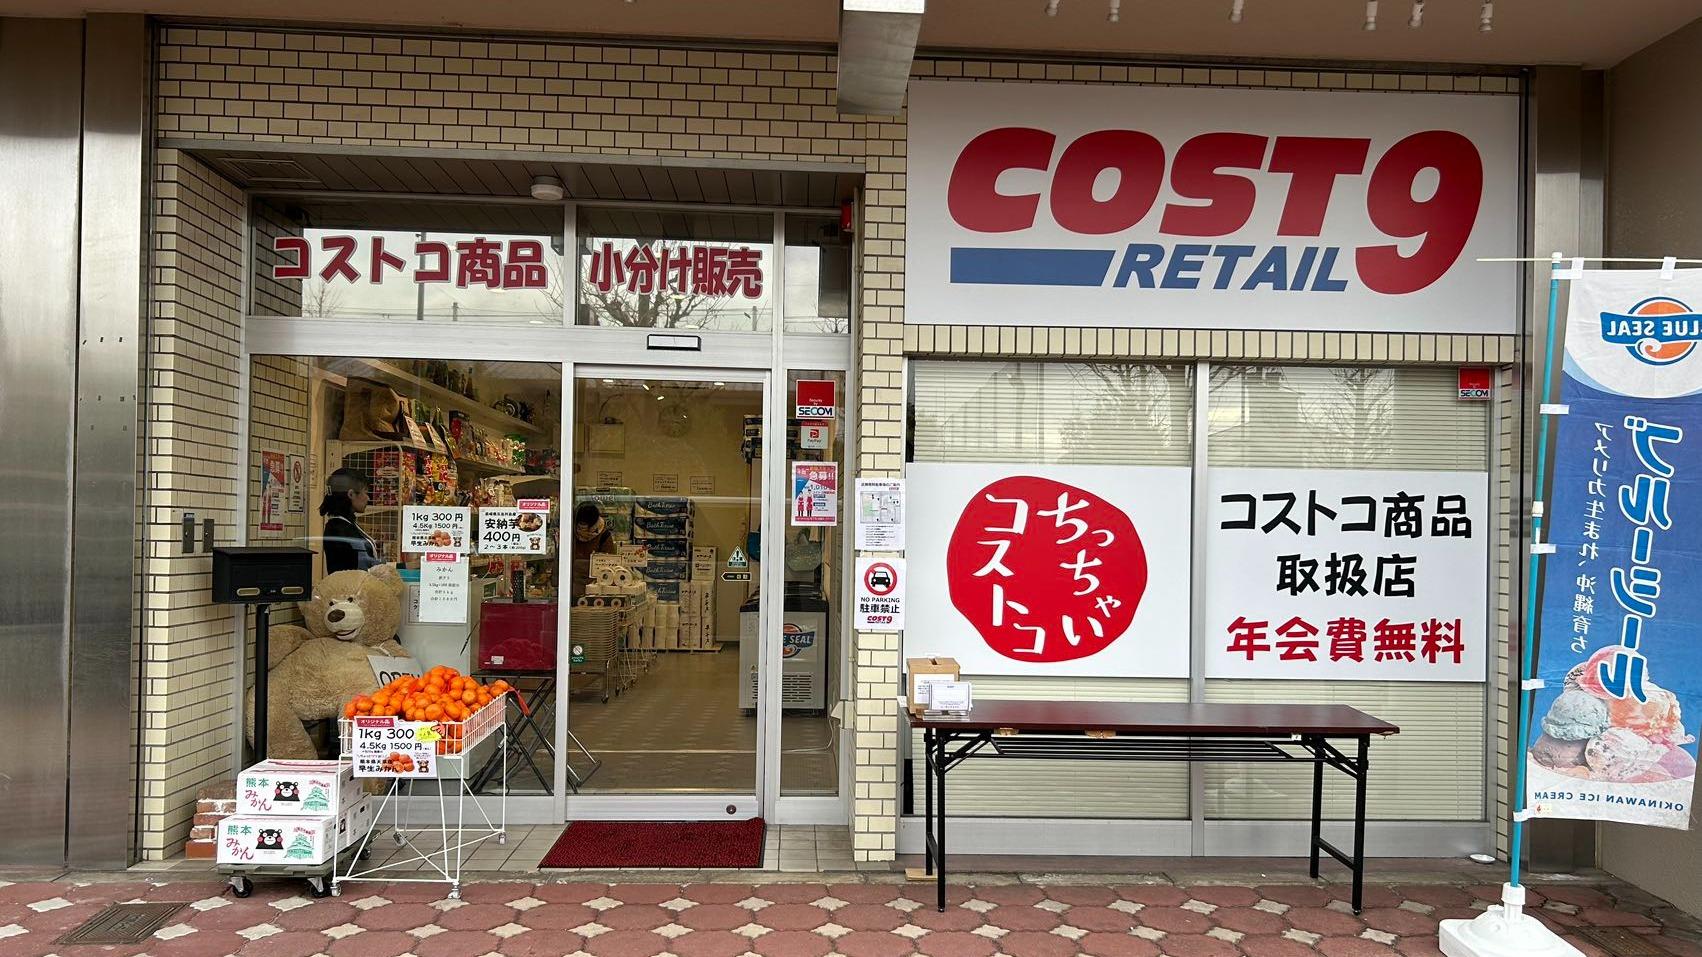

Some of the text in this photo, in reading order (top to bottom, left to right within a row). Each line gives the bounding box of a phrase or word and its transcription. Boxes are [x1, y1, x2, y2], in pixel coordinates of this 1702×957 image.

[946, 126, 1483, 295] COST9
[272, 235, 764, 299] コストコ商品 小分け販売
[1112, 244, 1349, 292] RETAIL
[1460, 389, 1488, 397] SECOM
[798, 407, 833, 416] SECOM
[432, 512, 452, 521] 300
[455, 513, 463, 522] 円
[1219, 490, 1474, 540] コストコ商品
[484, 518, 519, 529] 安納芋
[972, 492, 1046, 656] コストコ
[1036, 491, 1123, 648] ちっちゃい
[1276, 552, 1418, 598] 取扱店
[859, 603, 900, 614] 駐車禁止
[866, 615, 893, 624] COST9
[789, 635, 812, 644] SEAL
[1226, 615, 1466, 664] 年会費無料
[386, 728, 415, 739] 300
[390, 742, 412, 750] 1500
[414, 742, 422, 751] 円
[246, 777, 270, 788] 熊本
[244, 789, 272, 811] みかん
[227, 824, 252, 836] 熊本
[226, 837, 255, 860] みかん
